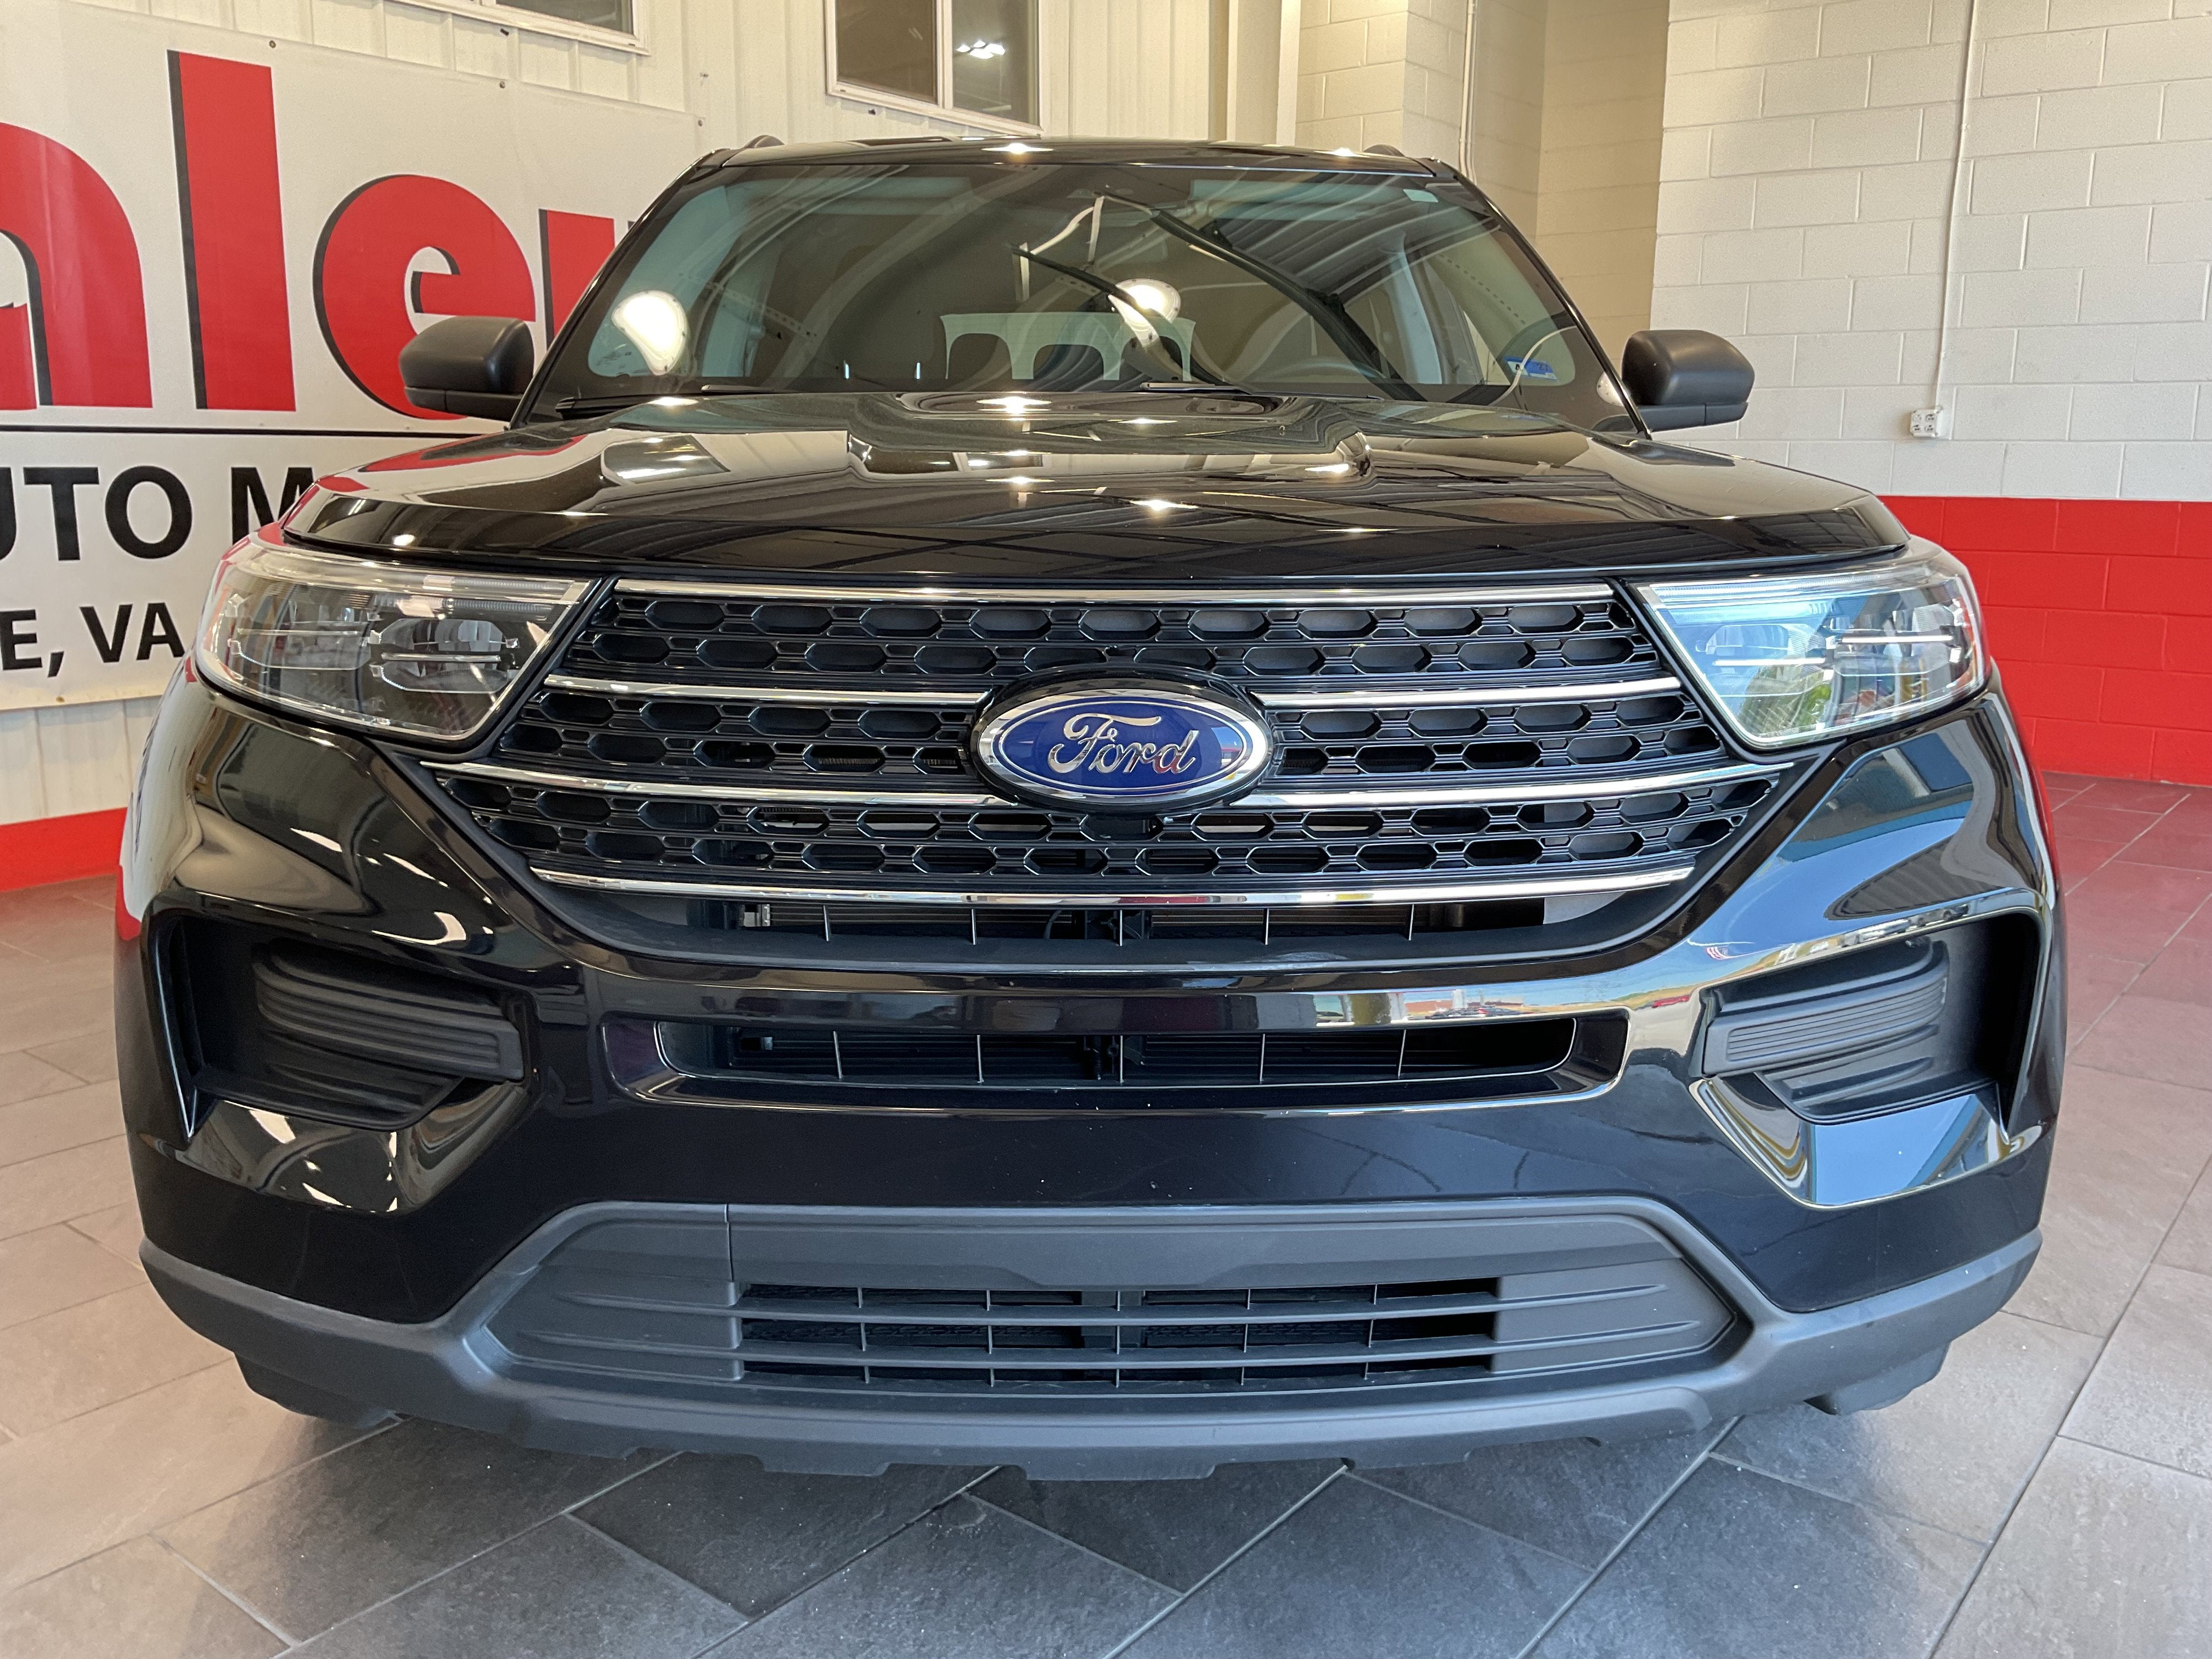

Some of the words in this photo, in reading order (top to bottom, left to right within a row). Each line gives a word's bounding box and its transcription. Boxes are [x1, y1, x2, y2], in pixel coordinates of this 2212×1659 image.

[0, 465, 192, 561] TO
[79, 602, 185, 663] VA
[1048, 713, 1199, 774] Ford
